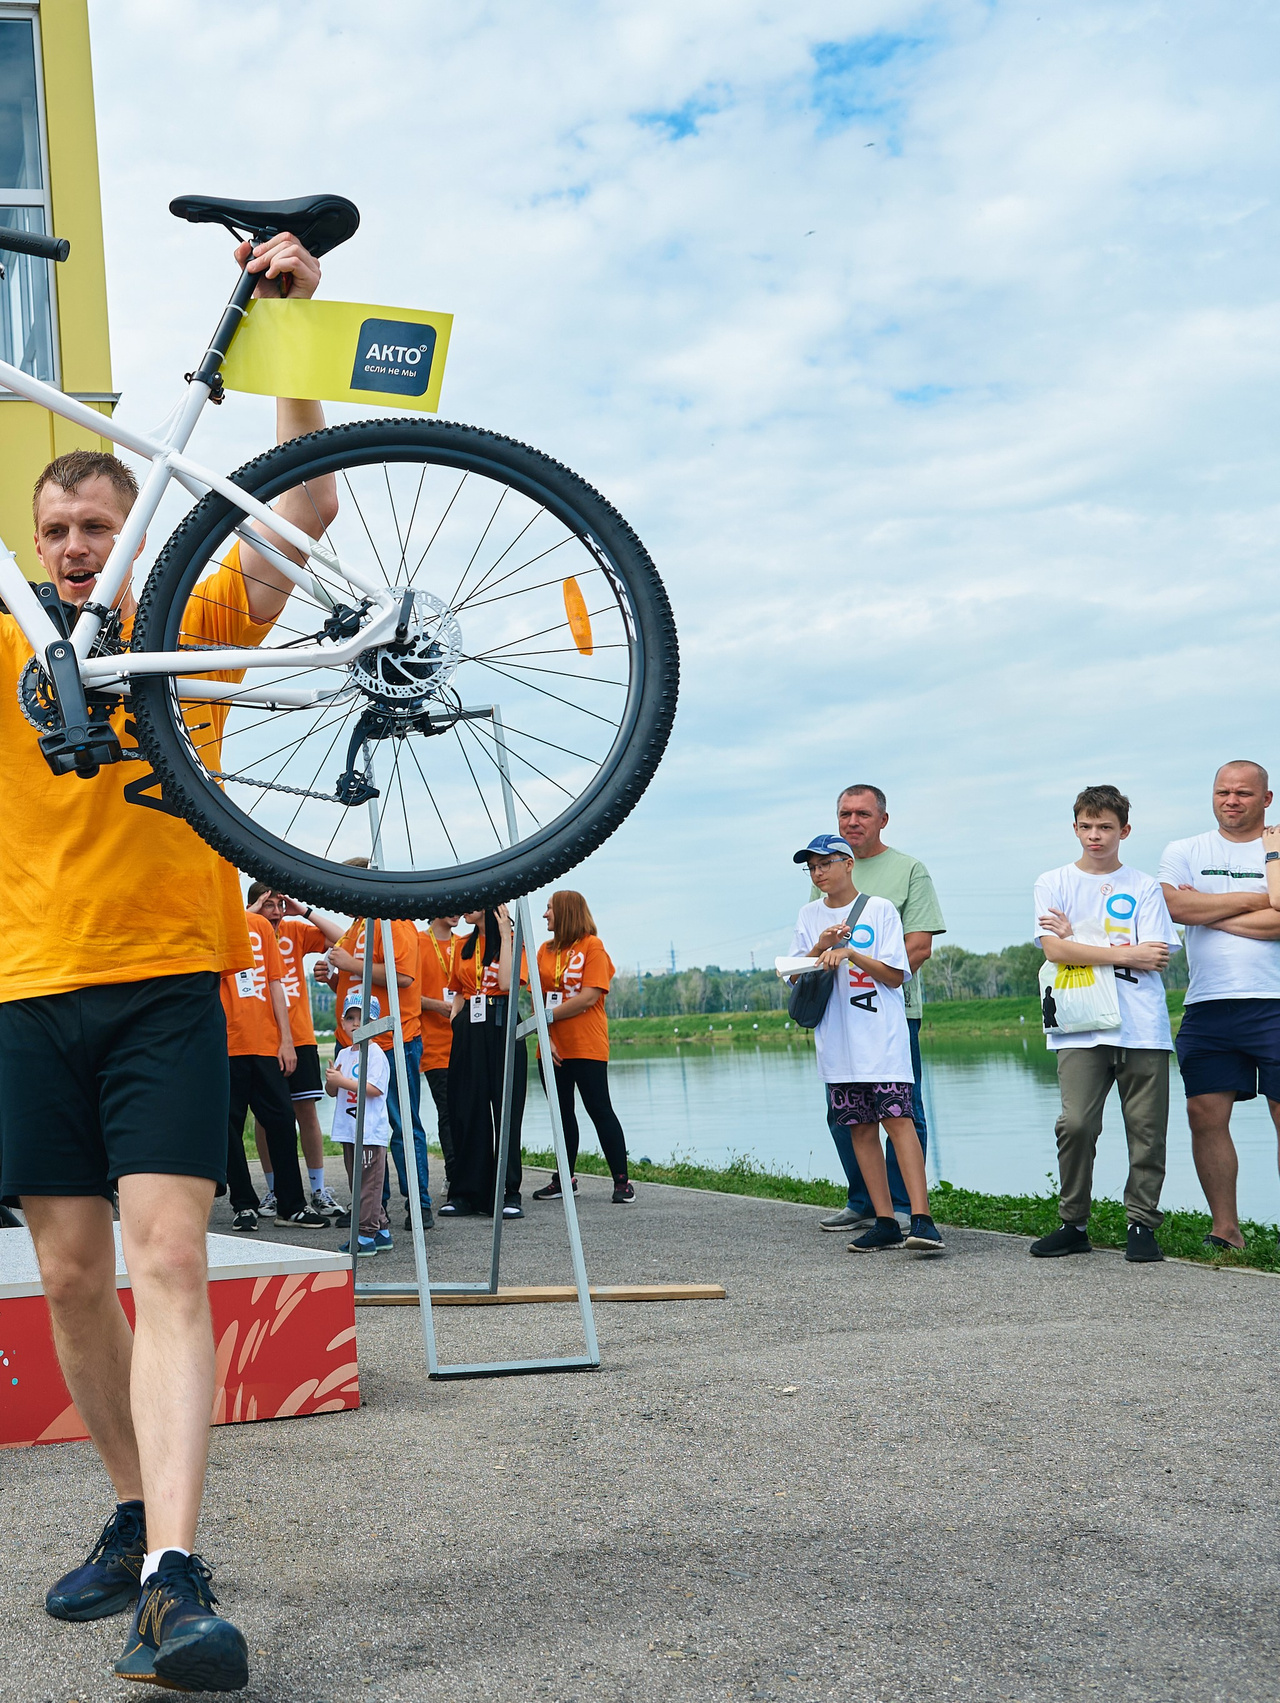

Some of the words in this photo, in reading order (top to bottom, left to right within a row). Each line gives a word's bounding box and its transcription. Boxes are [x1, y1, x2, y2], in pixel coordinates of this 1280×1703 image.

[364, 364, 386, 374] если
[388, 367, 400, 375] не
[401, 369, 417, 378] мы
[365, 343, 422, 365] АКТО
[1104, 893, 1139, 985] АТО
[563, 951, 585, 998] КТО
[848, 924, 878, 1013] АКО
